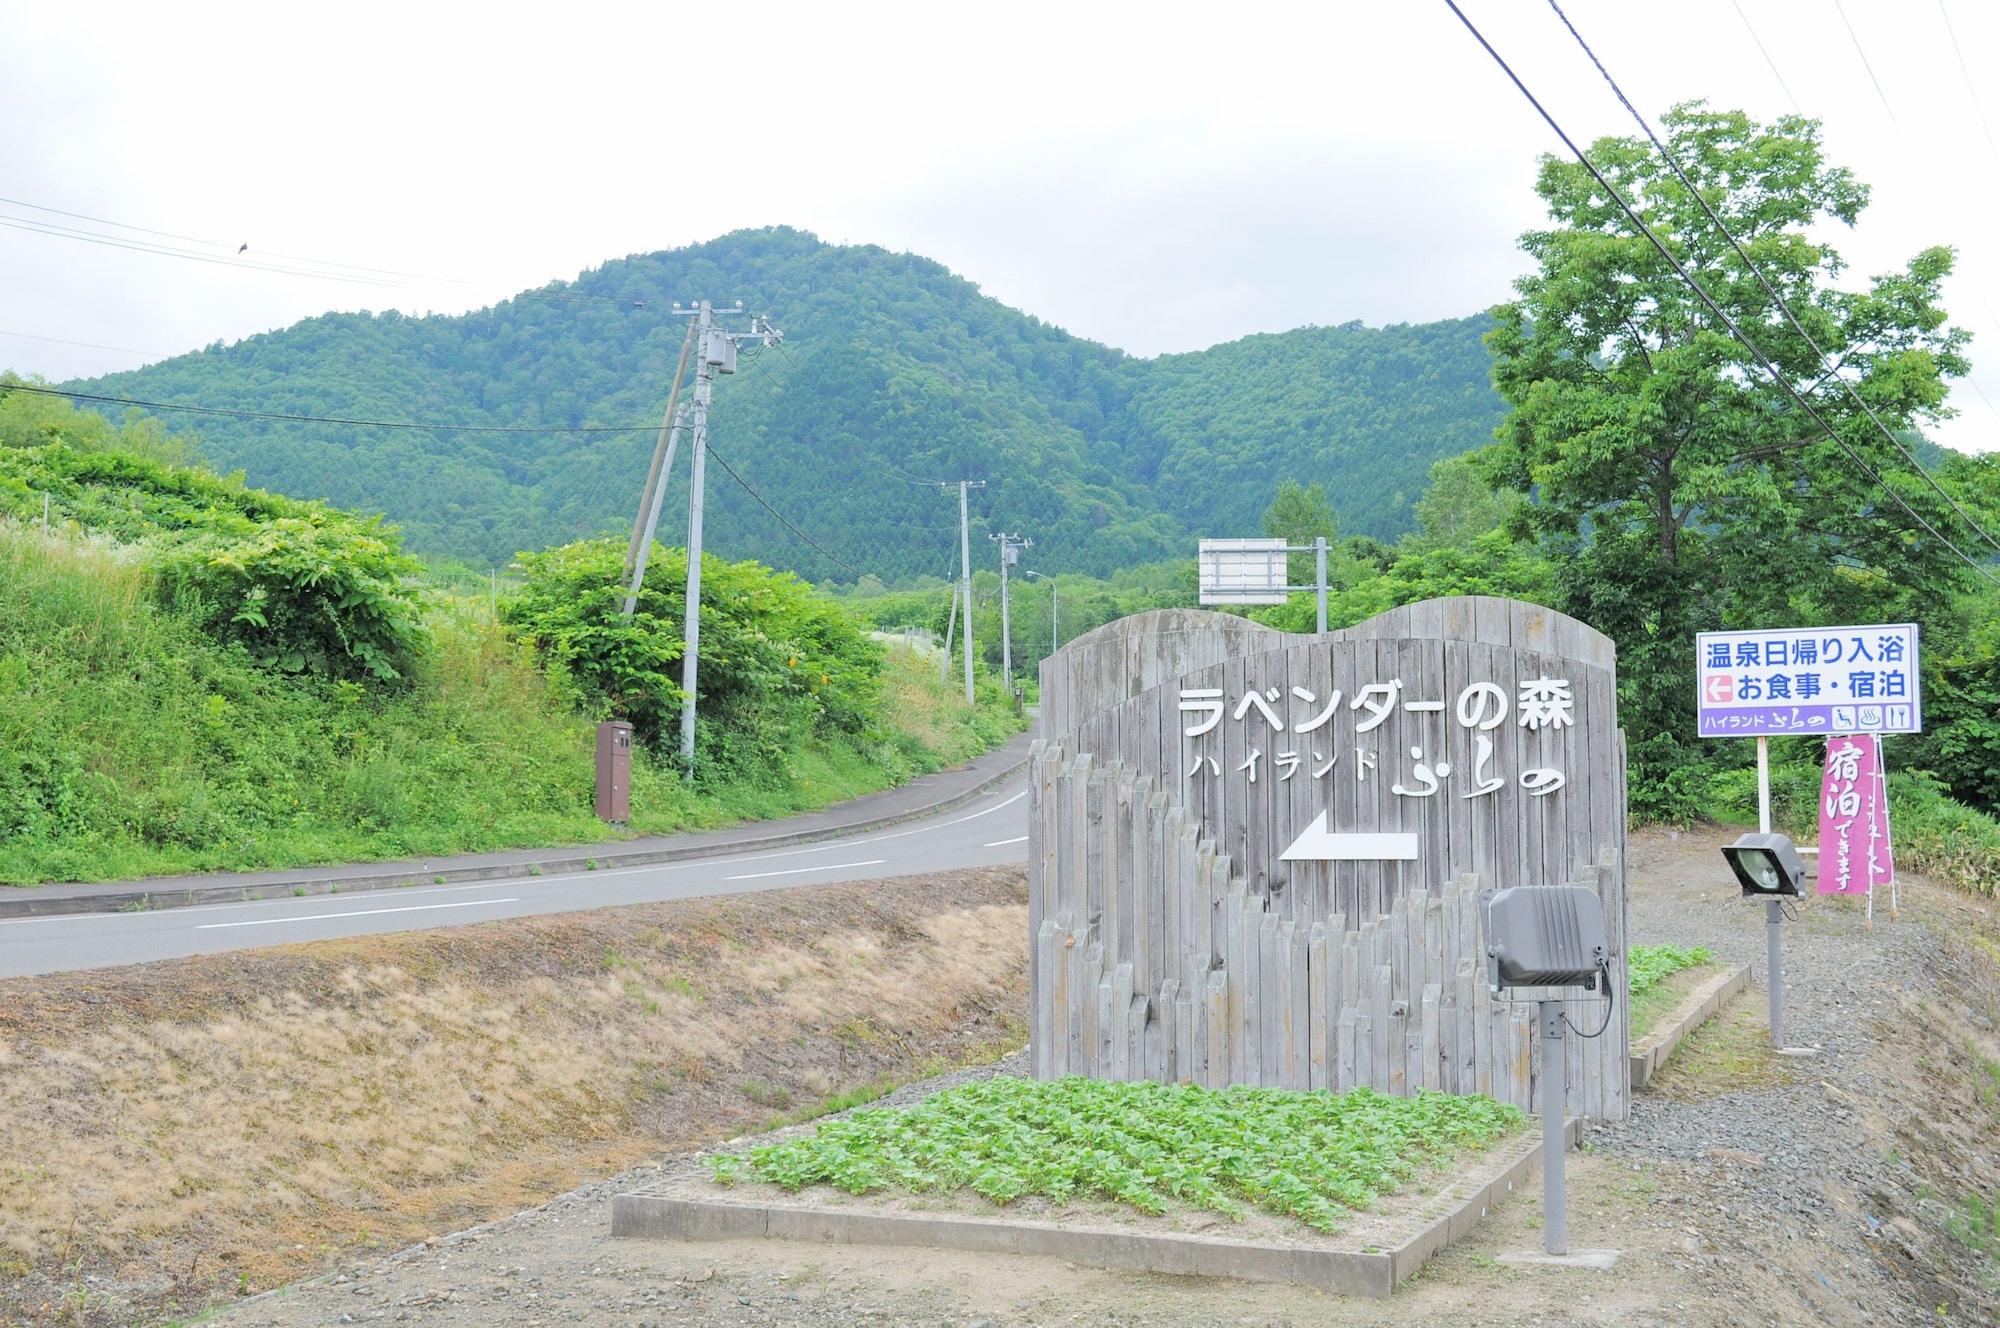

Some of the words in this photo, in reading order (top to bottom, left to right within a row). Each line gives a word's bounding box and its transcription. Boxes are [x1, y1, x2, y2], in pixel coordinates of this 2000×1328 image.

[1707, 635, 1904, 668] 温泉日帰り入浴
[1178, 676, 1573, 736] ラベンダーの森
[1738, 669, 1905, 700] お食事・宿泊
[1826, 742, 1864, 890] 宿泊できます
